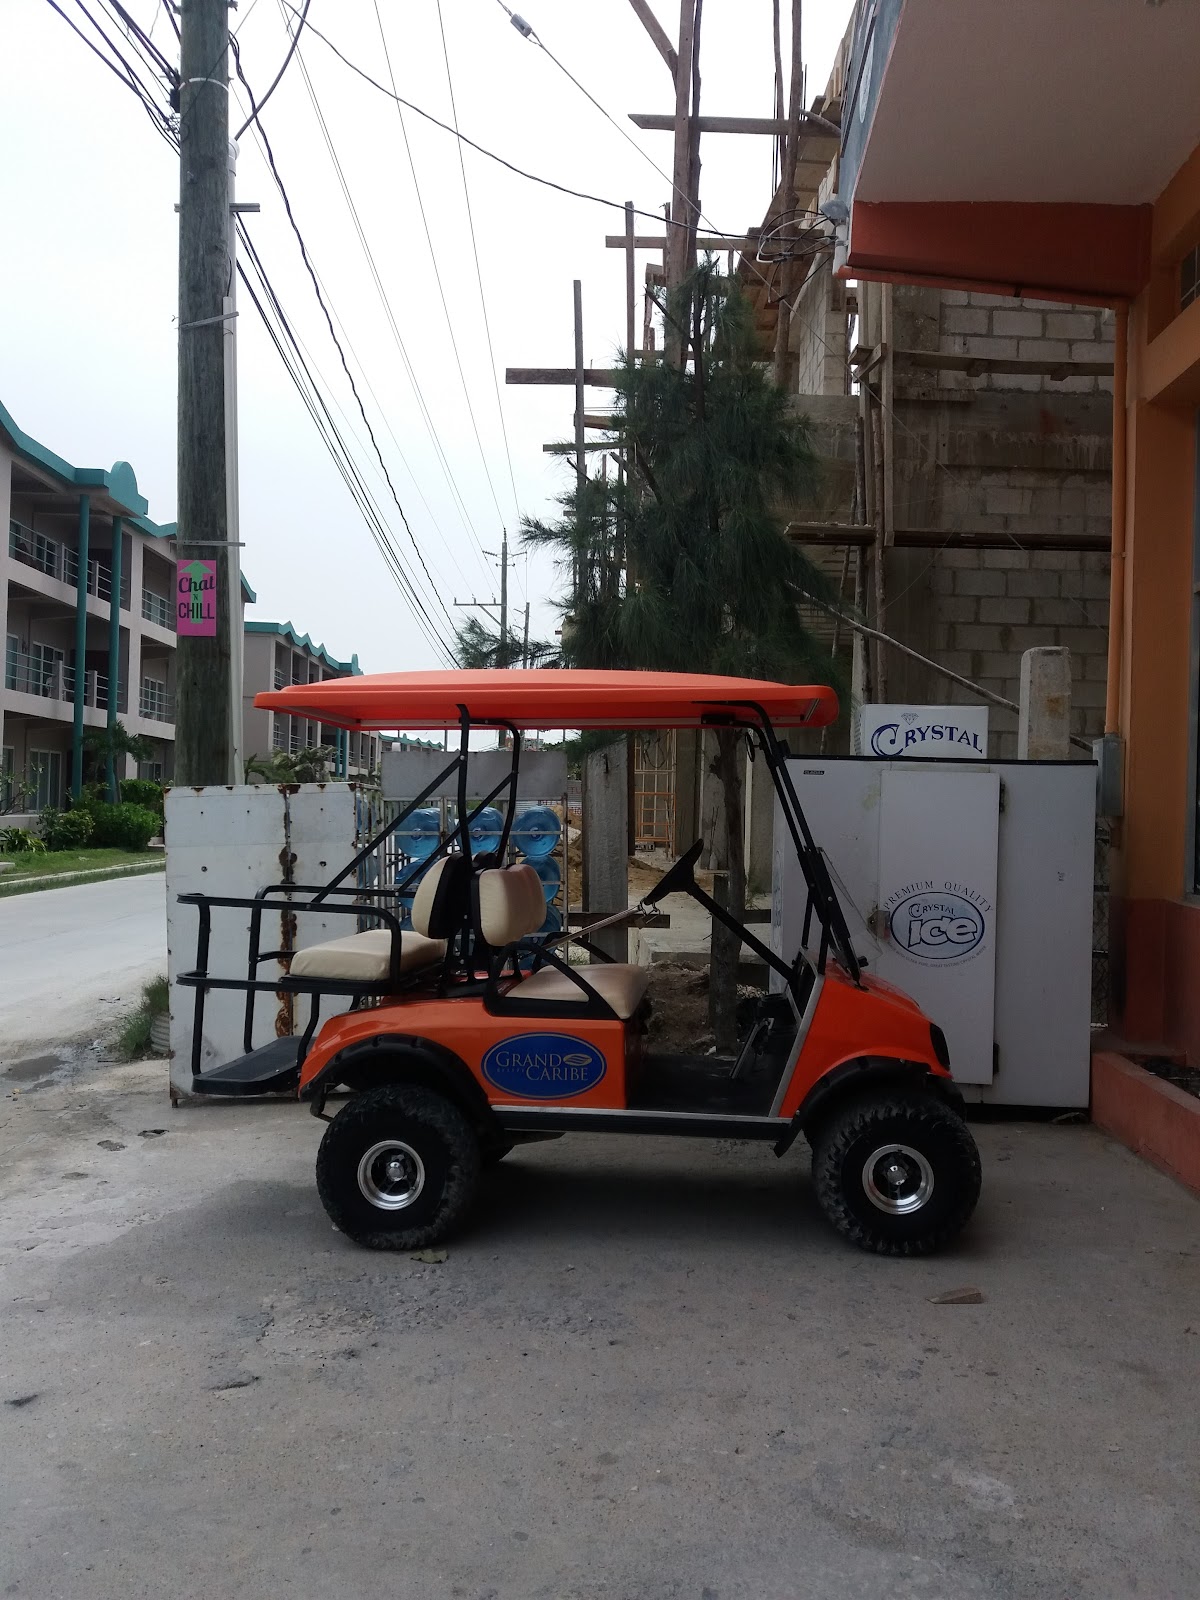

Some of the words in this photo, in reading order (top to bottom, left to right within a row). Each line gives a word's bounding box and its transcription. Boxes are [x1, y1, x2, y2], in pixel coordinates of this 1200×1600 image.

[178, 576, 215, 593] Chat
[178, 602, 215, 619] CHILL
[871, 723, 983, 756] CRYSTAL
[883, 881, 934, 910] PREMIUM
[944, 881, 993, 913] QUALITY
[908, 903, 956, 918] CRYSTAL
[496, 1051, 562, 1067] GRAND
[526, 1065, 589, 1081] CARIBE
